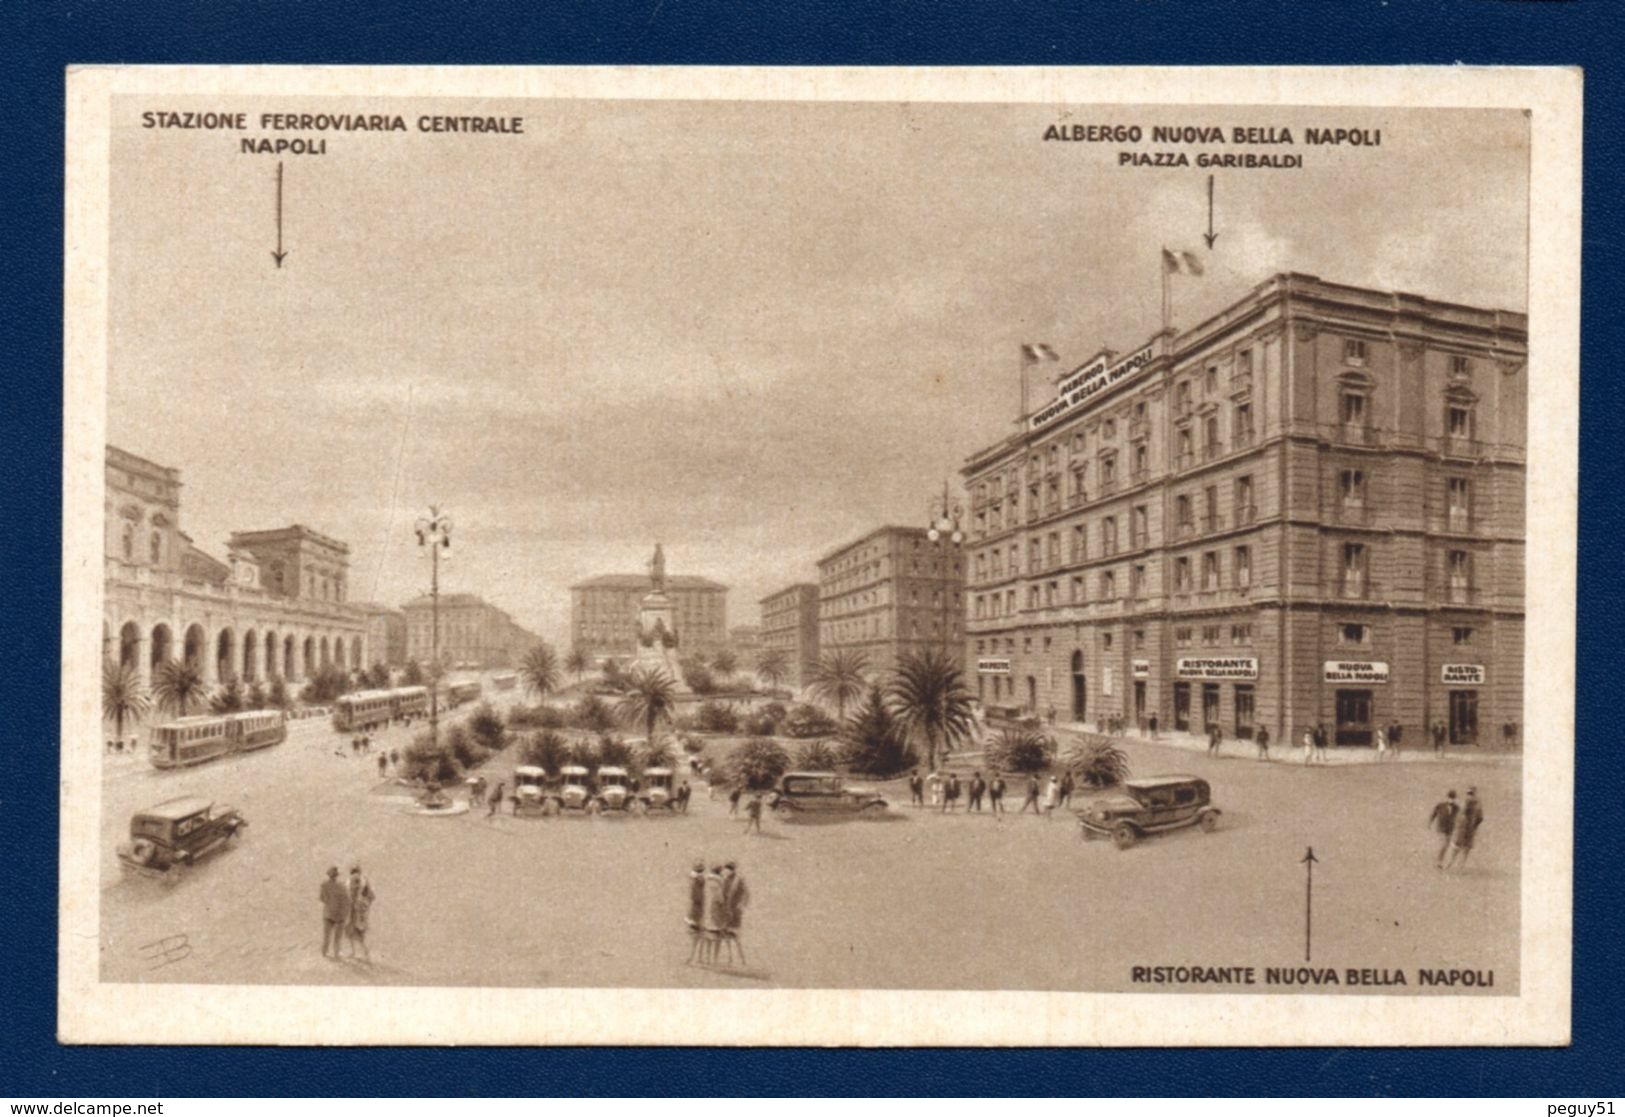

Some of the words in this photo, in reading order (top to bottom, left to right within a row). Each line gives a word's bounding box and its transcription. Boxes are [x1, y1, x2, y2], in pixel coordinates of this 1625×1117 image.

[142, 111, 246, 130] STAZIONE
[261, 113, 407, 132] FERROVIARIA
[418, 115, 524, 134] CENTRALE
[1043, 124, 1142, 143] ALBERGO
[1152, 126, 1226, 144] NUOVA
[1233, 127, 1294, 145] BELLA
[1305, 128, 1381, 147] NAPOLI
[241, 138, 326, 155] NAPOLI
[1119, 152, 1189, 167] PIAZZA
[1196, 153, 1303, 169] GARIBALDI
[1033, 400, 1069, 426] NUOVA
[1072, 378, 1108, 404] BELLA
[1109, 349, 1152, 382] NAPOLI
[1060, 363, 1104, 396] ALBERGO
[1182, 660, 1253, 668] RISTORANTE
[1338, 663, 1373, 671] NUOVA
[1326, 672, 1353, 680] BELLA
[1354, 672, 1388, 680] NAPOLI
[1132, 966, 1256, 985] RISTORANTE
[1265, 967, 1340, 985] NUOVA
[1345, 968, 1408, 986] BELLA
[1418, 968, 1494, 988] NAPOLI
